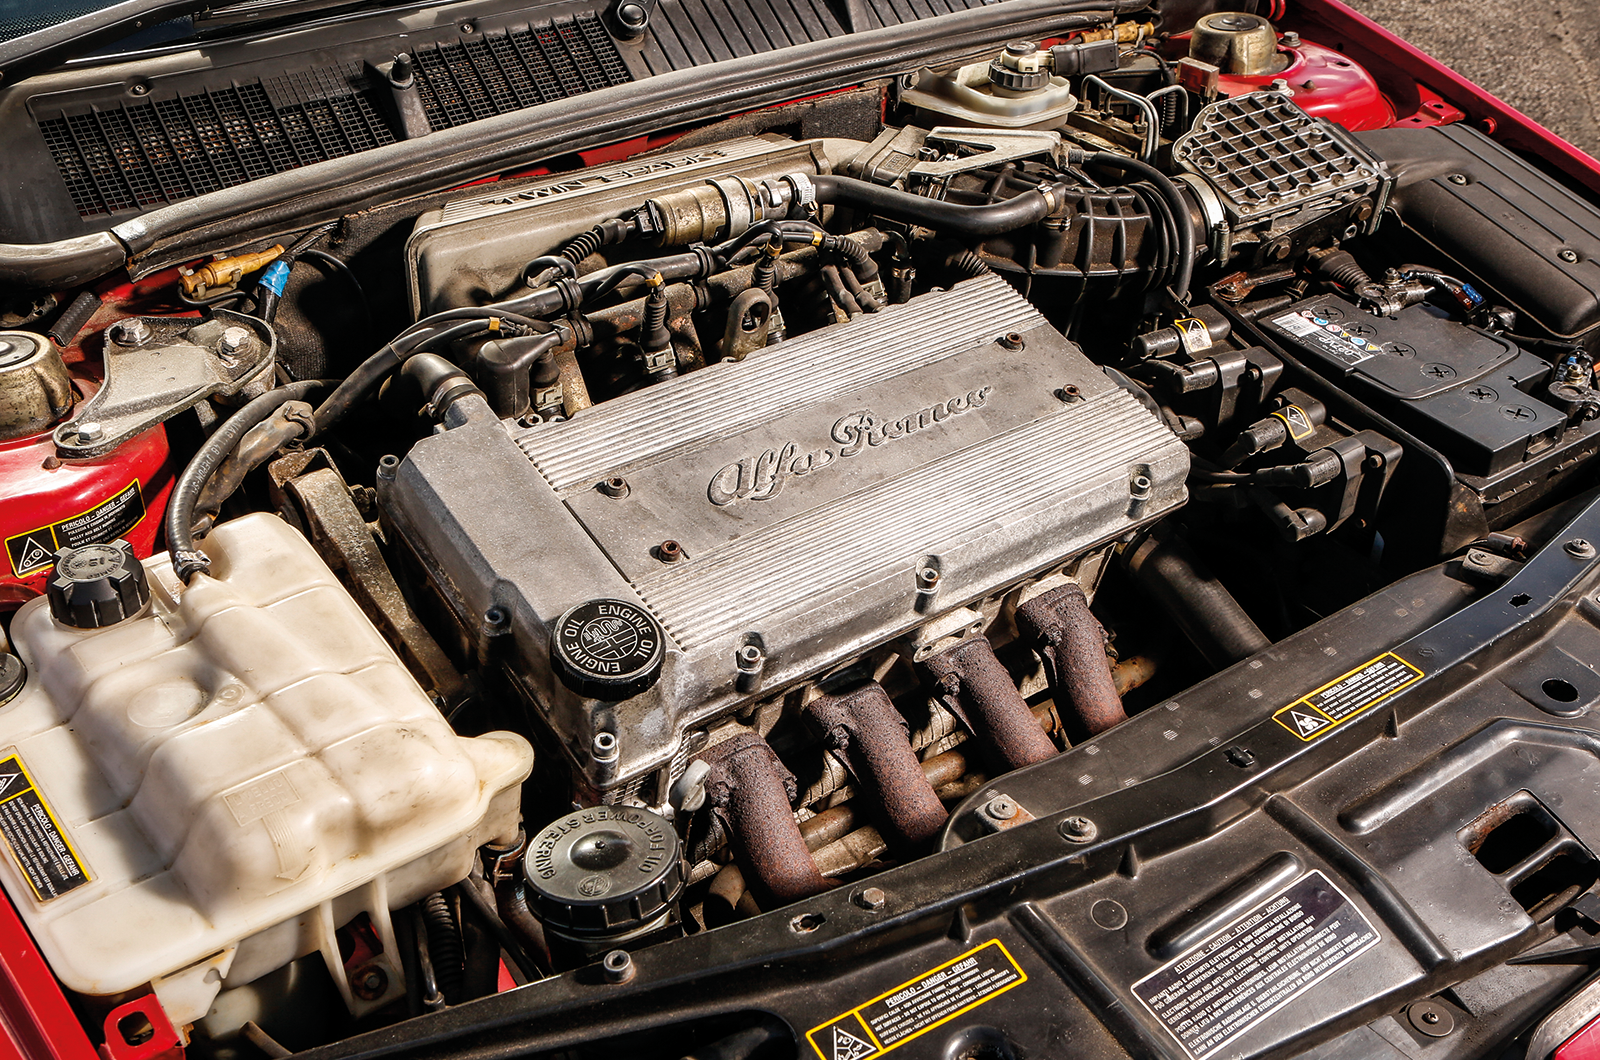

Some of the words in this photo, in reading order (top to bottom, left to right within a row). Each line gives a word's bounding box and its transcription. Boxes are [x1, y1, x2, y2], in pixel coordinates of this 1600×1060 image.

[487, 180, 588, 204] TWIN
[596, 152, 714, 183] SPARK
[706, 441, 836, 507] Alfa
[829, 386, 992, 458] Romeo
[62, 516, 90, 531] PERICOLO
[96, 501, 116, 516] DANGER
[564, 619, 585, 638] OIL
[598, 605, 652, 635] ENGINE
[633, 640, 654, 659] OIL
[566, 642, 621, 673] ENGINE
[33, 804, 52, 830] PERICOLO
[49, 831, 66, 854] DANGER
[63, 854, 80, 877] GEFAHR
[582, 811, 654, 829] POWER
[645, 826, 665, 850] FOR
[536, 818, 581, 879] STEERING
[638, 853, 664, 873] OIL
[1174, 950, 1206, 973] ATTENZIONE
[1208, 933, 1232, 951] CAUTION
[1234, 914, 1263, 934] ATTENTION
[1265, 896, 1290, 914] ACHTUNG
[885, 987, 917, 1006] PERICOLO
[921, 972, 948, 988] DANGER
[951, 957, 978, 973] GEFAHR
[1162, 998, 1190, 1019] ELECTRONIC
[1188, 990, 1203, 1002] RADIO
[1201, 983, 1213, 993] AND
[1211, 967, 1238, 987] ANTI-THEFT
[1277, 922, 1308, 943] INSTALLATION
[1304, 915, 1317, 925] MAY
[1167, 1007, 1191, 1025] GENERATE
[1222, 977, 1236, 989] WITH
[1234, 961, 1261, 981] ELECTRONIC
[1259, 948, 1280, 964] CONTROL
[1290, 925, 1315, 944] OPERATION
[1168, 980, 1184, 993] RADIO
[1192, 1009, 1208, 1022] RADIO
[1277, 943, 1308, 965] INSTALLATION
[1198, 1018, 1211, 1028] LIEU
[1213, 1008, 1224, 1018] DES
[1264, 965, 1289, 984] CENTRALES
[1188, 1023, 1224, 1049] ELEKTRONISCHE
